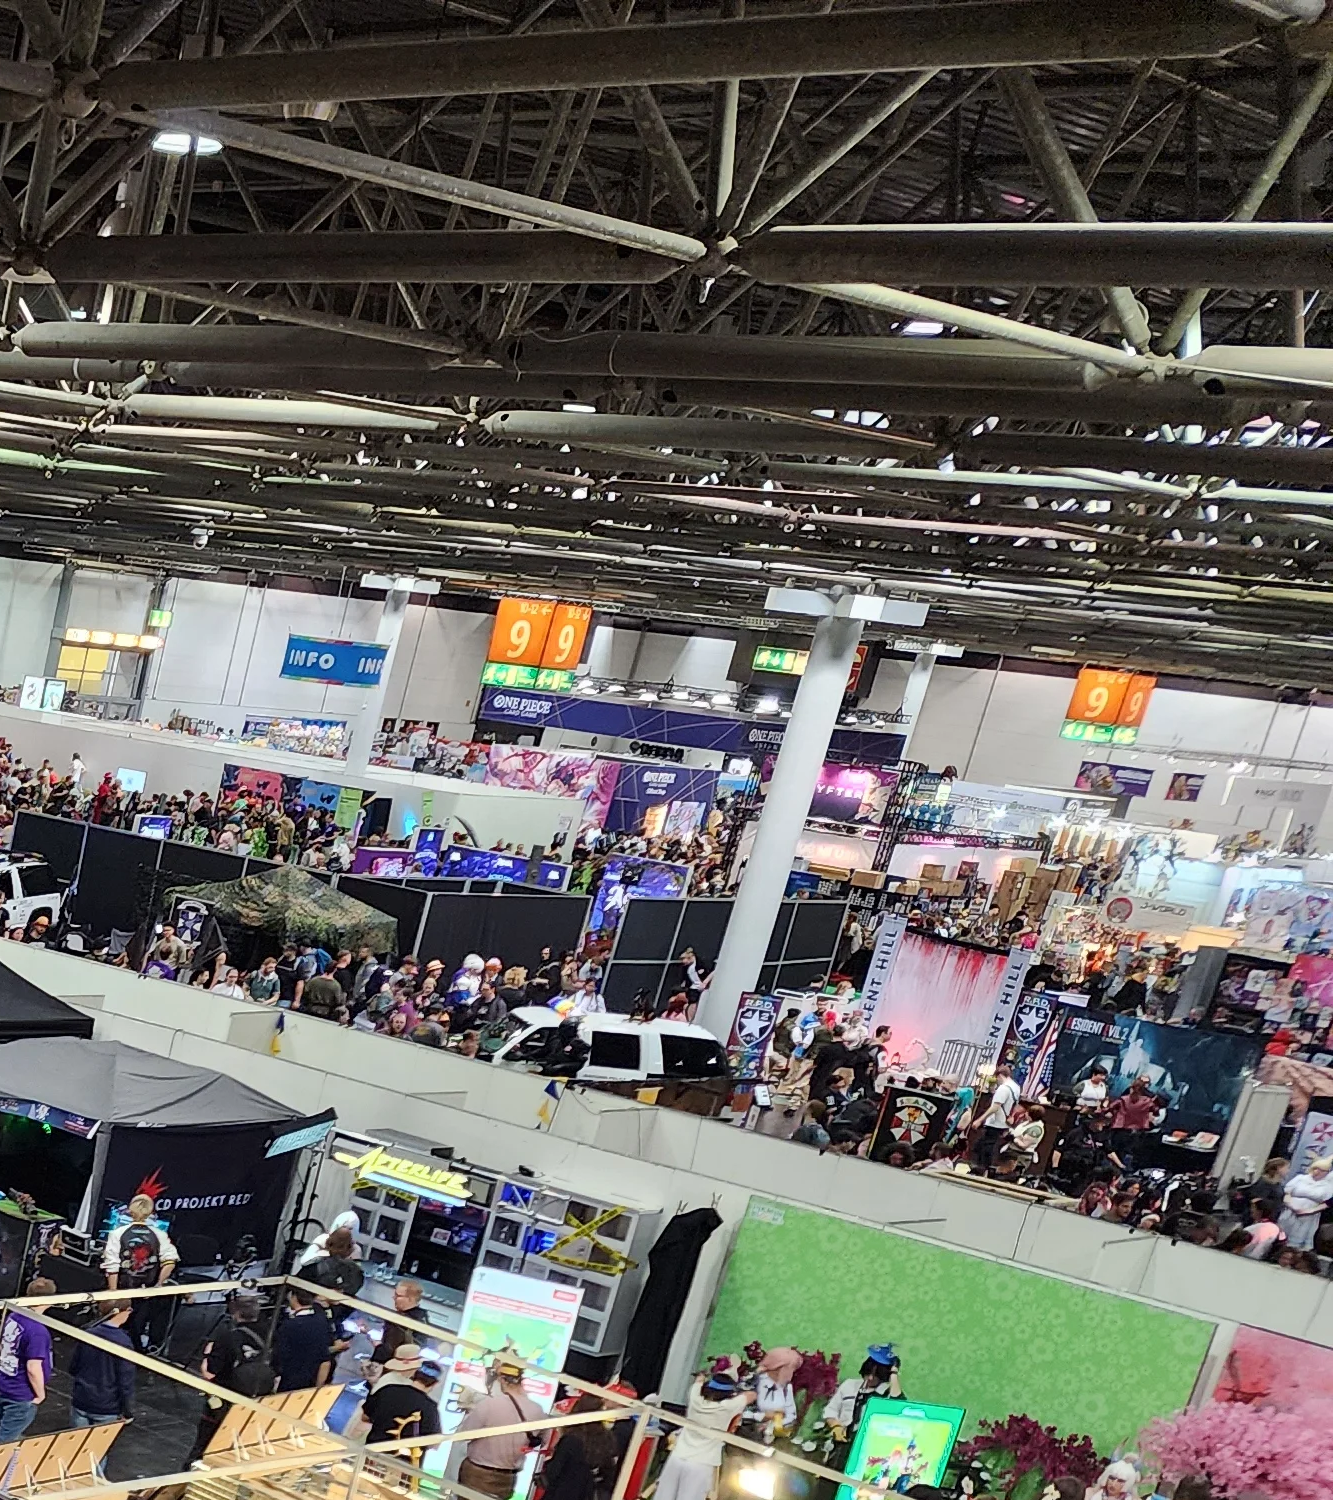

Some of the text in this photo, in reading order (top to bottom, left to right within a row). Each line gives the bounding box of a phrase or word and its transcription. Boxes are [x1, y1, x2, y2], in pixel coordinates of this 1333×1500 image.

[506, 620, 531, 658] 9
[554, 624, 575, 663] 9
[289, 649, 335, 670] INFO
[357, 657, 383, 675] INF
[493, 695, 552, 714] ONE PIECE
[1084, 687, 1109, 718] 9
[1125, 692, 1143, 722] 9
[749, 729, 768, 742] ONE
[816, 784, 863, 800] YFTER
[875, 930, 898, 970] HILL
[1000, 962, 1023, 1006] HILL
[1065, 1016, 1104, 1036] RESIDENT
[1102, 1023, 1122, 1039] EVIL
[1120, 1028, 1130, 1041] 2
[155, 1193, 251, 1211] CD PROJEKT RED
